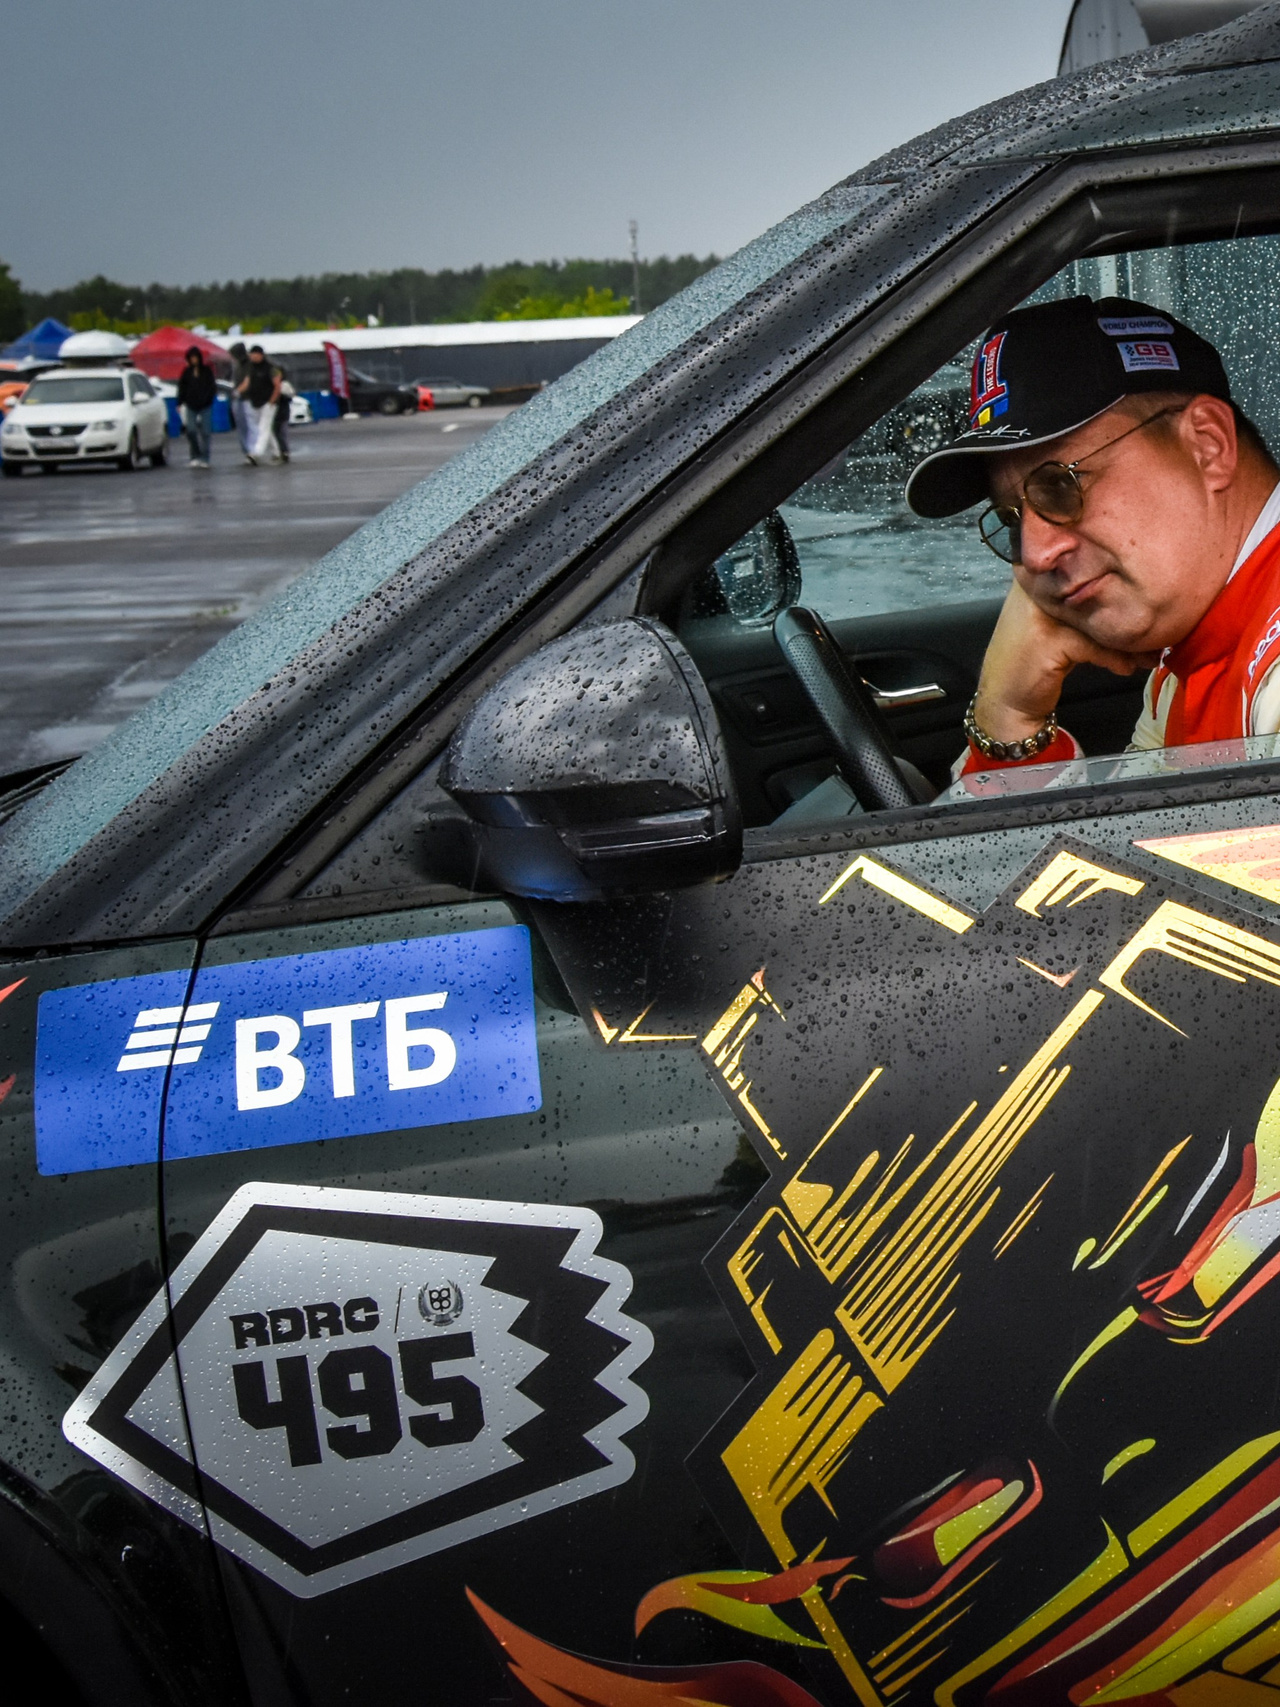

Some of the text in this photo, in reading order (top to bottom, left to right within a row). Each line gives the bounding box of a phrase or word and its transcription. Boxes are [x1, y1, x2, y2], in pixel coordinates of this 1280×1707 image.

[1134, 343, 1171, 357] GB
[235, 992, 457, 1111] ВТБ
[229, 1296, 380, 1350] RDRC
[232, 1332, 486, 1468] 495
